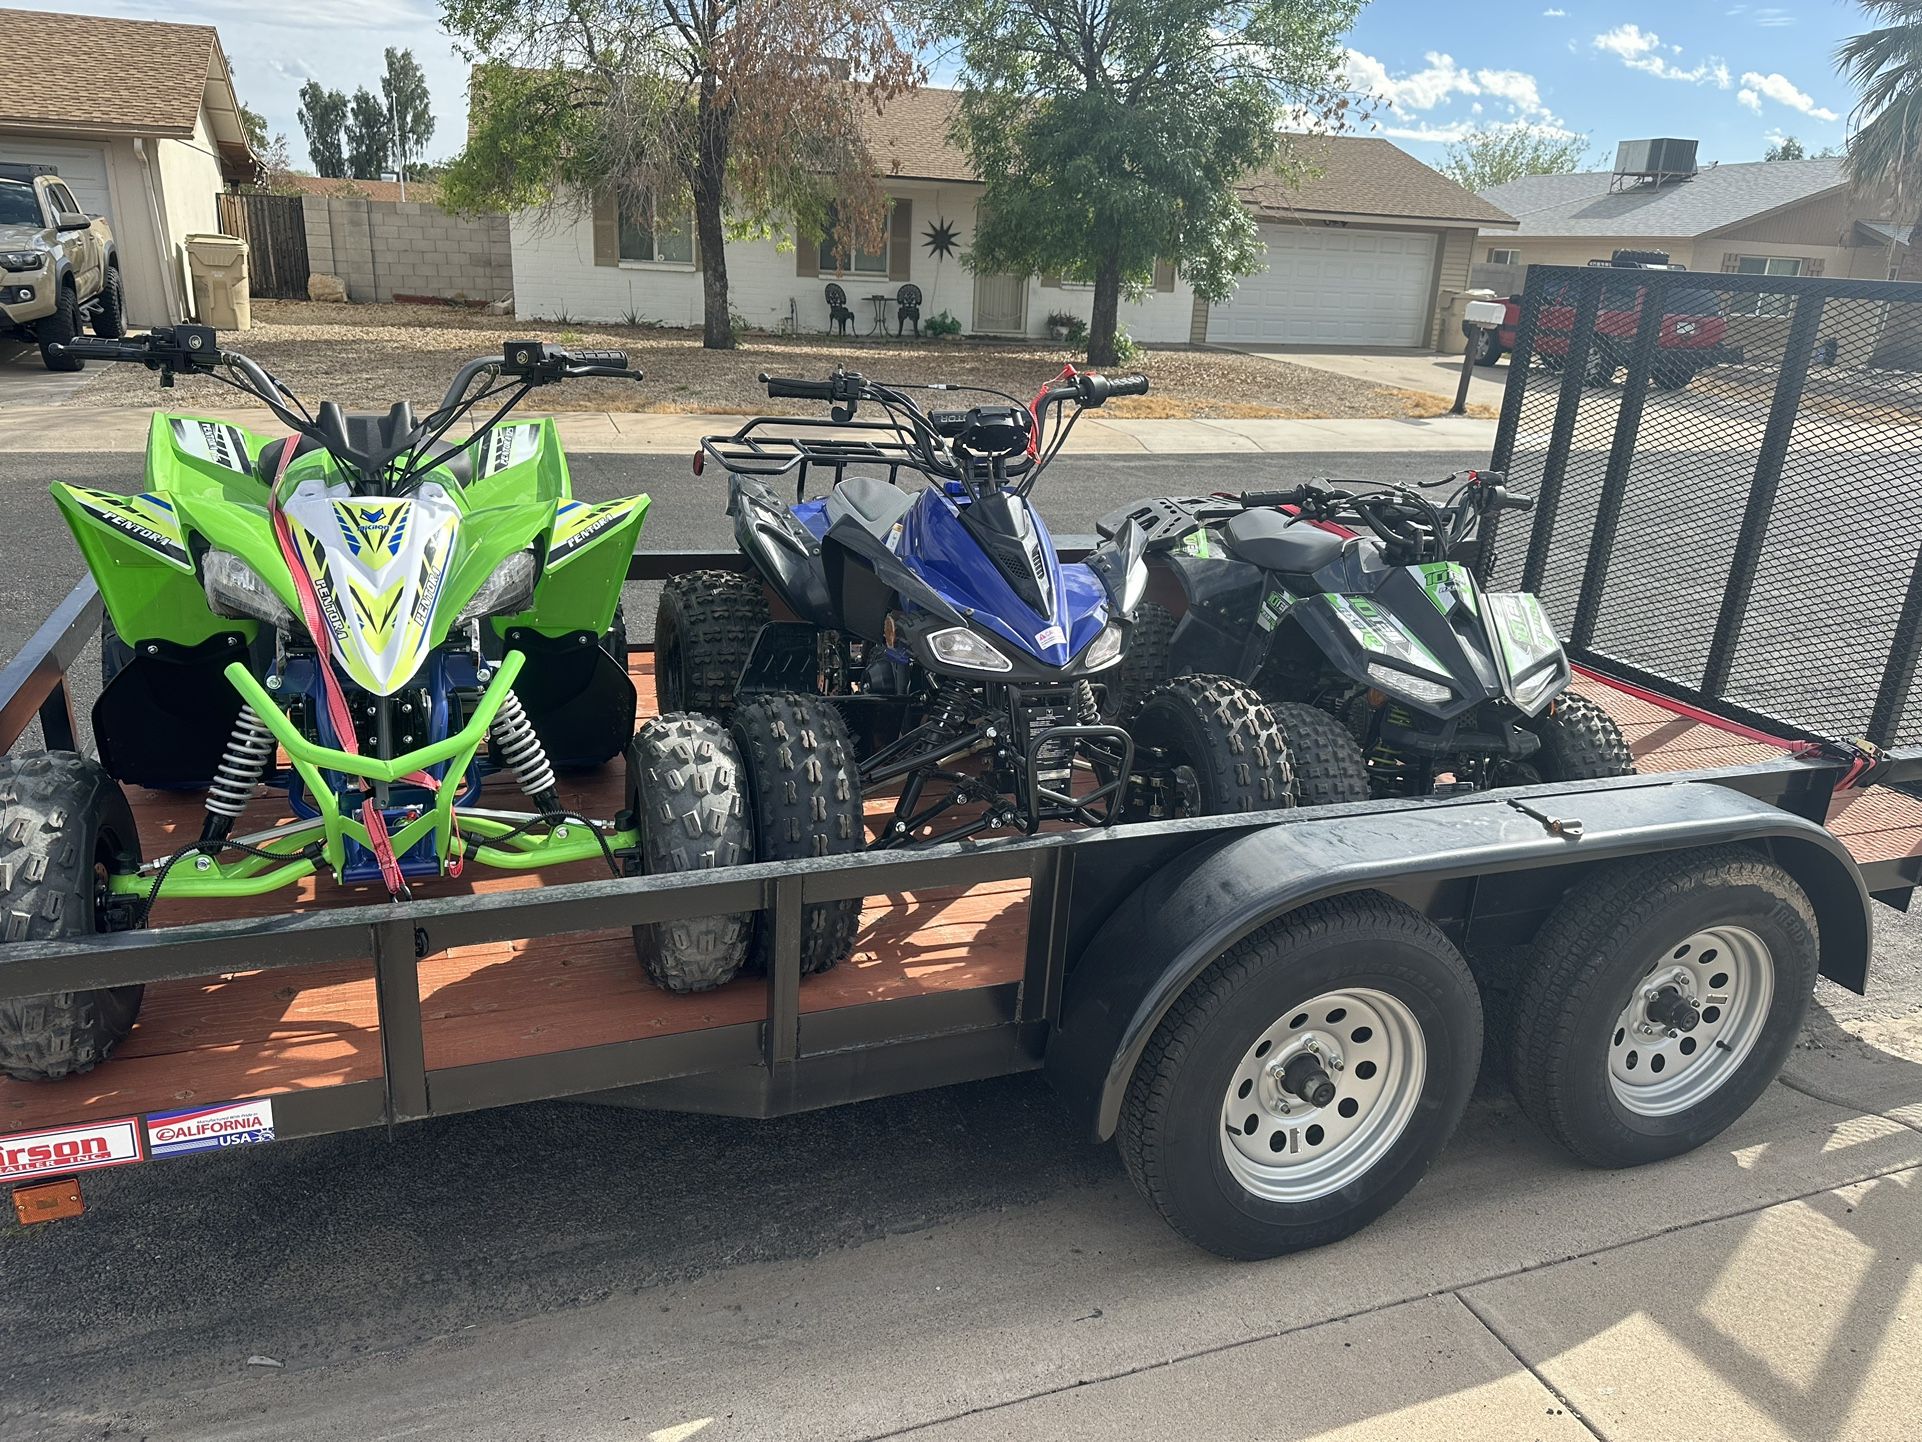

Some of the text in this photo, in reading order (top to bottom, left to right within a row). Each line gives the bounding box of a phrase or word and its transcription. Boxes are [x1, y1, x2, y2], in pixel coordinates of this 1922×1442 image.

[102, 511, 171, 546] PENTORA
[566, 513, 614, 549] PENTORA
[315, 578, 349, 641] PENTORA
[415, 565, 441, 627] PENTORA
[156, 1116, 262, 1141] CALIFORNIA
[219, 1132, 252, 1147] USA
[0, 1137, 108, 1167] rson
[70, 1152, 108, 1164] INC.
